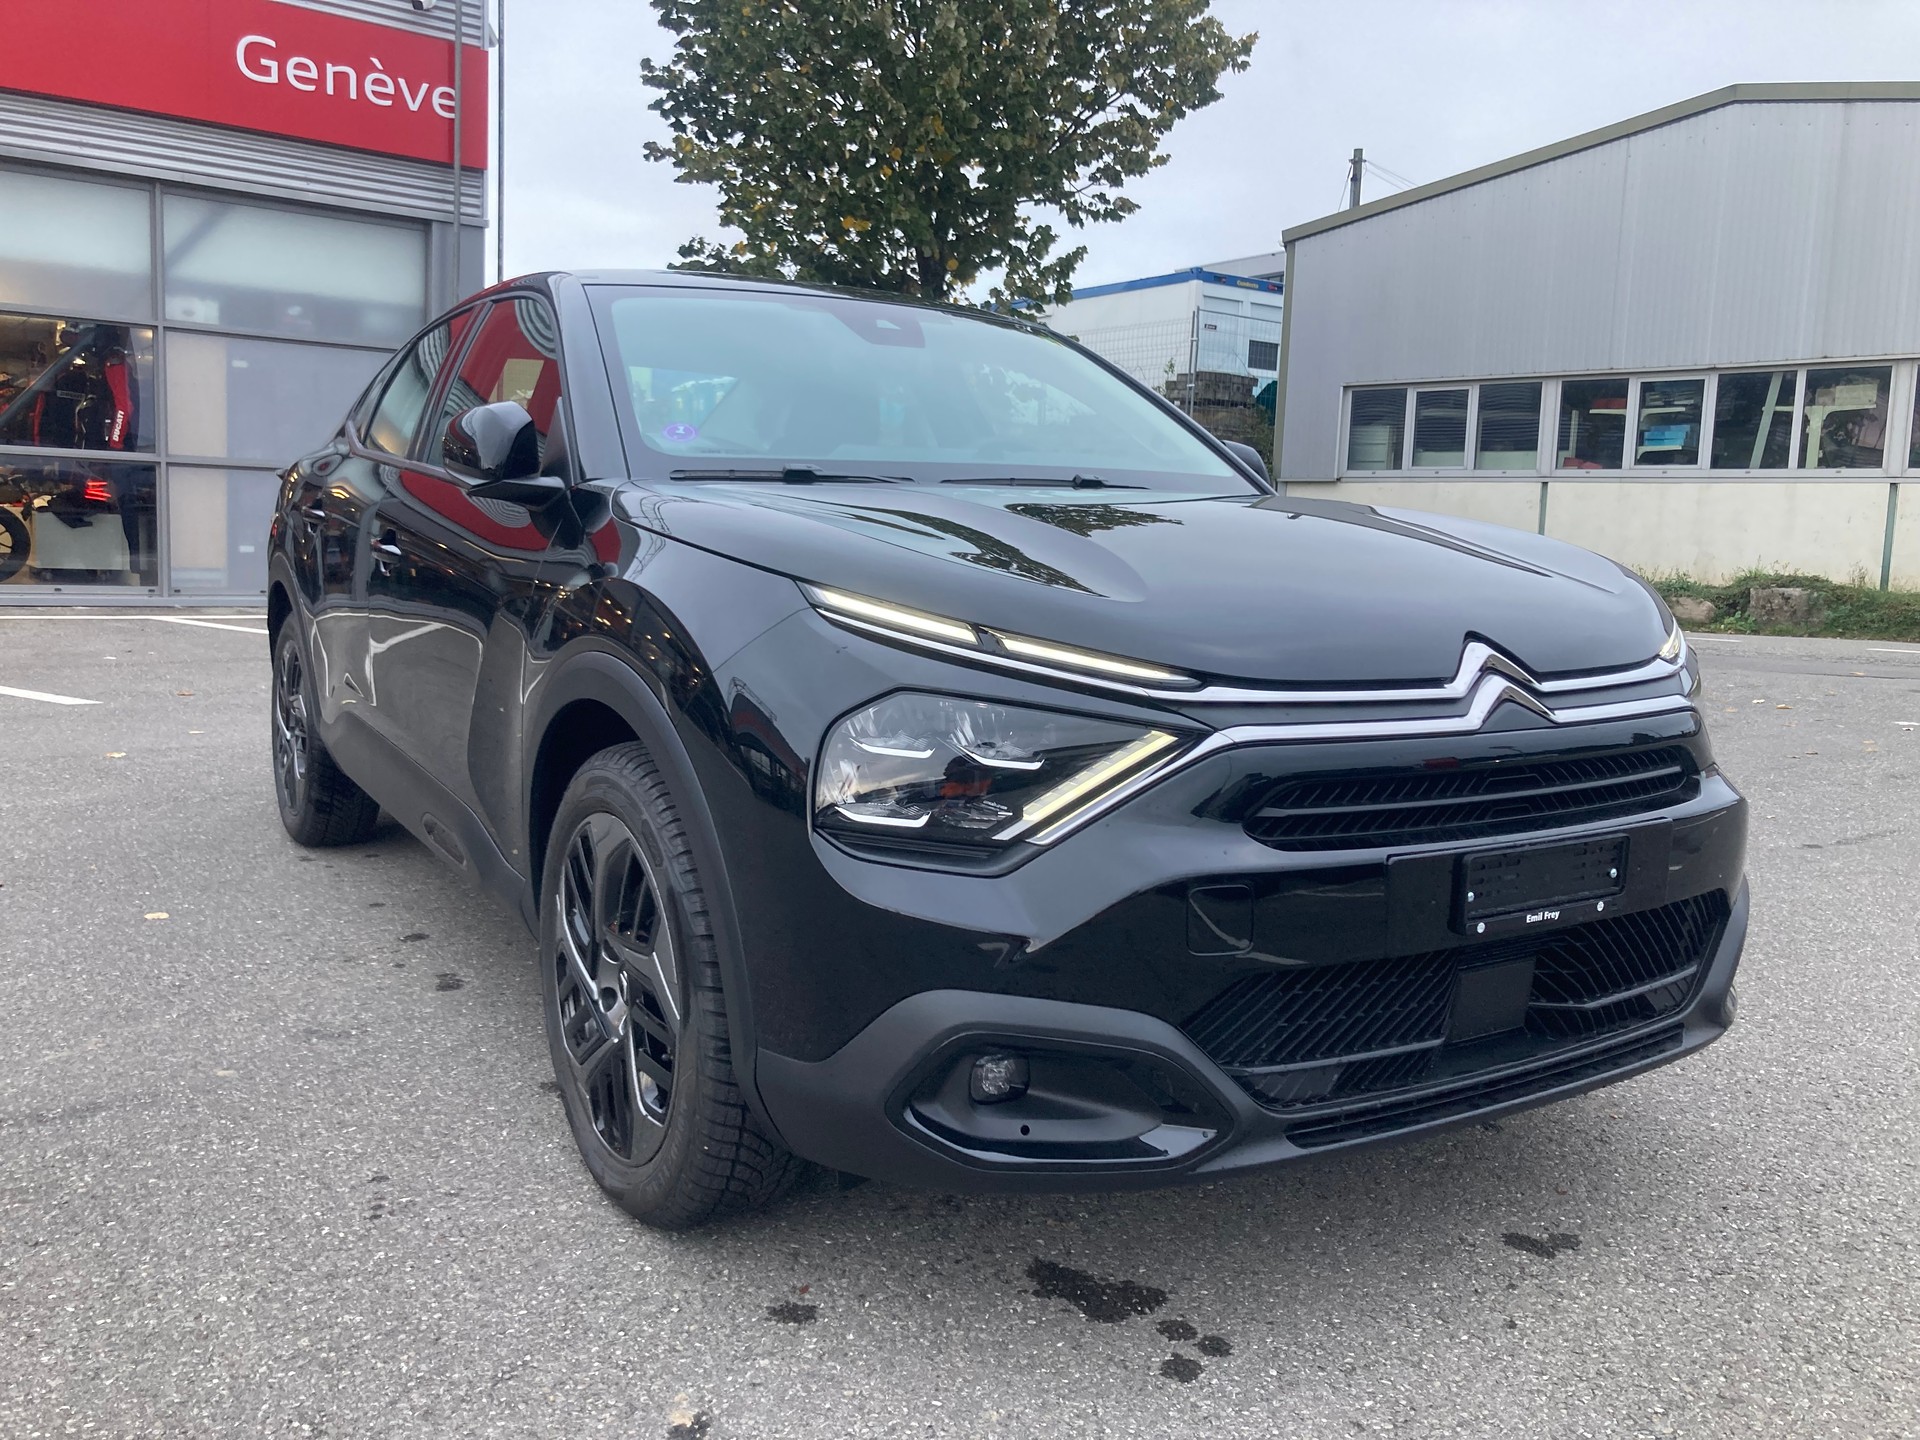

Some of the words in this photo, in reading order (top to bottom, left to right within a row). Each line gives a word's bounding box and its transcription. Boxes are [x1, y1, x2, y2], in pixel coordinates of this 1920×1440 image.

[236, 35, 457, 119] Genève
[112, 410, 125, 442] DUCATI
[1526, 911, 1543, 923] Emil
[1544, 911, 1560, 920] Frey
